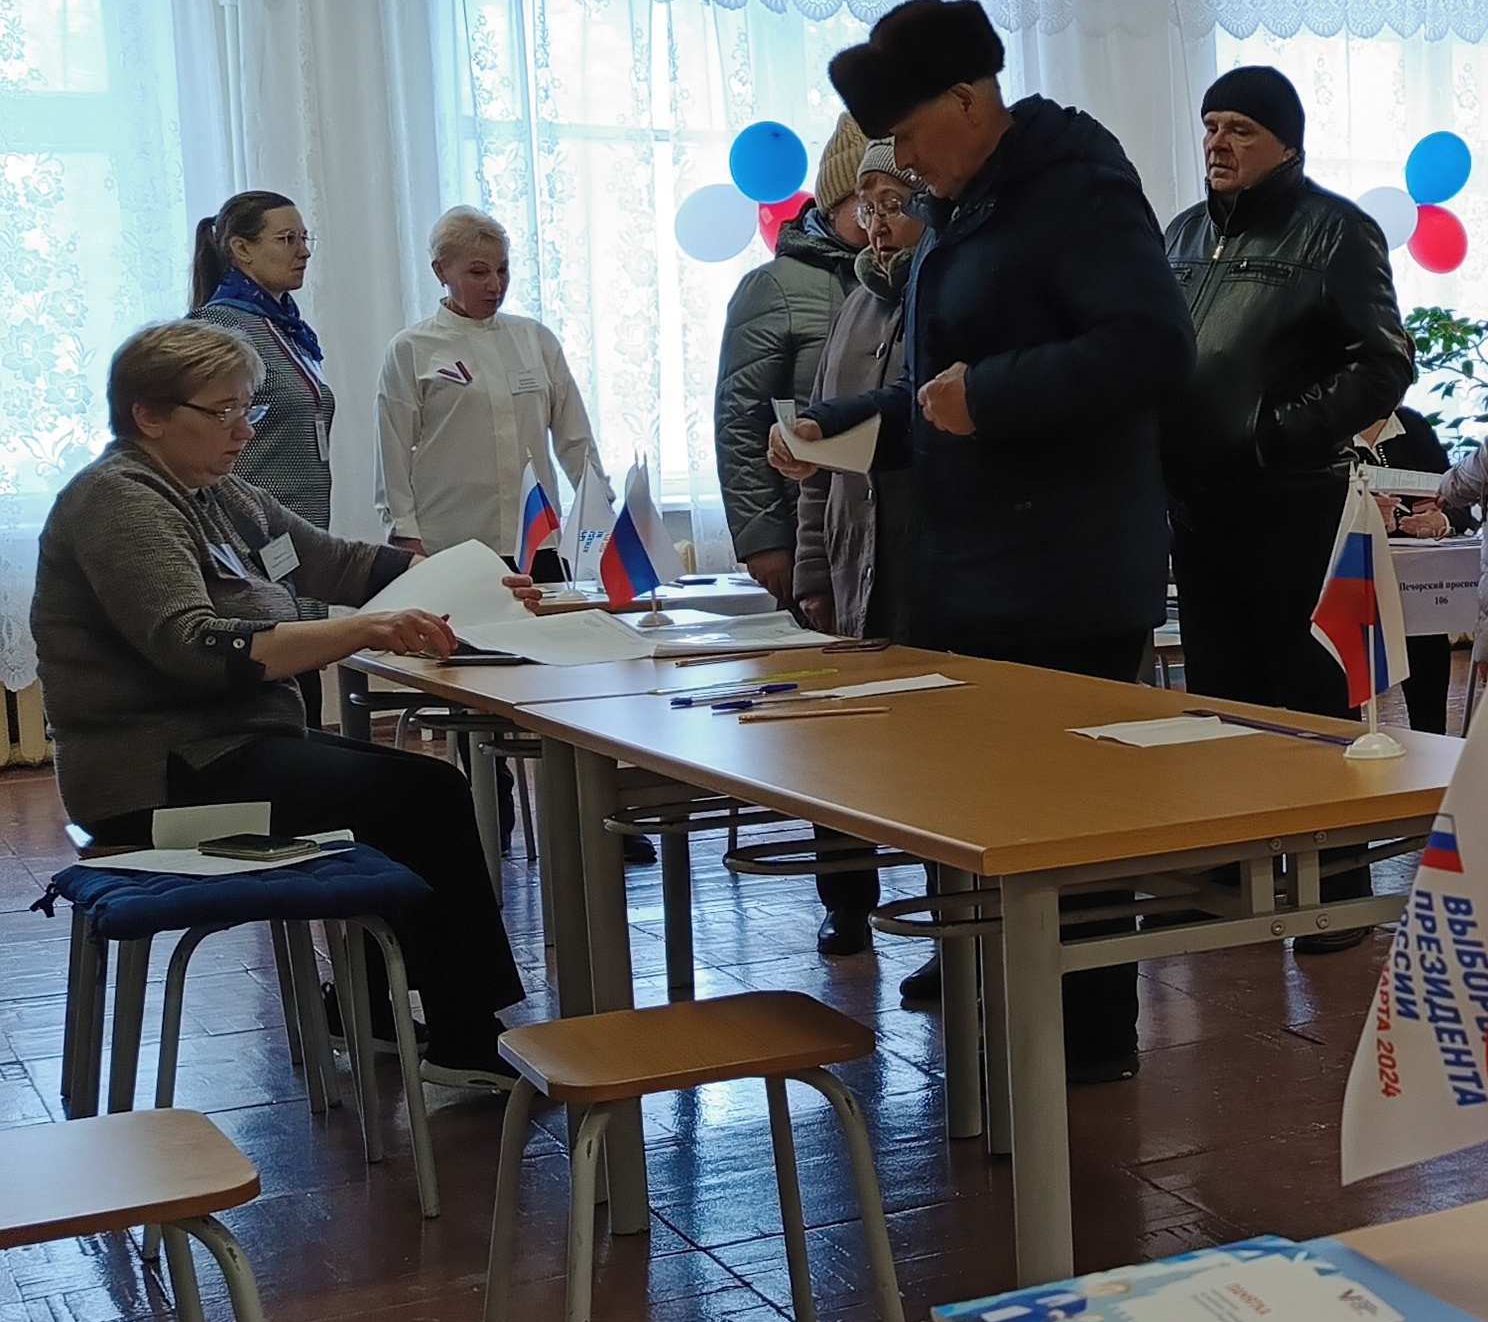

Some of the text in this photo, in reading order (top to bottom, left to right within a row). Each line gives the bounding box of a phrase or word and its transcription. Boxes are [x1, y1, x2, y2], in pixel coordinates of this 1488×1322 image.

[1399, 581, 1444, 592] Печорский
[1415, 889, 1488, 1107] ПРЕЗИДЕНТА
[1377, 1040, 1401, 1098] 2024
